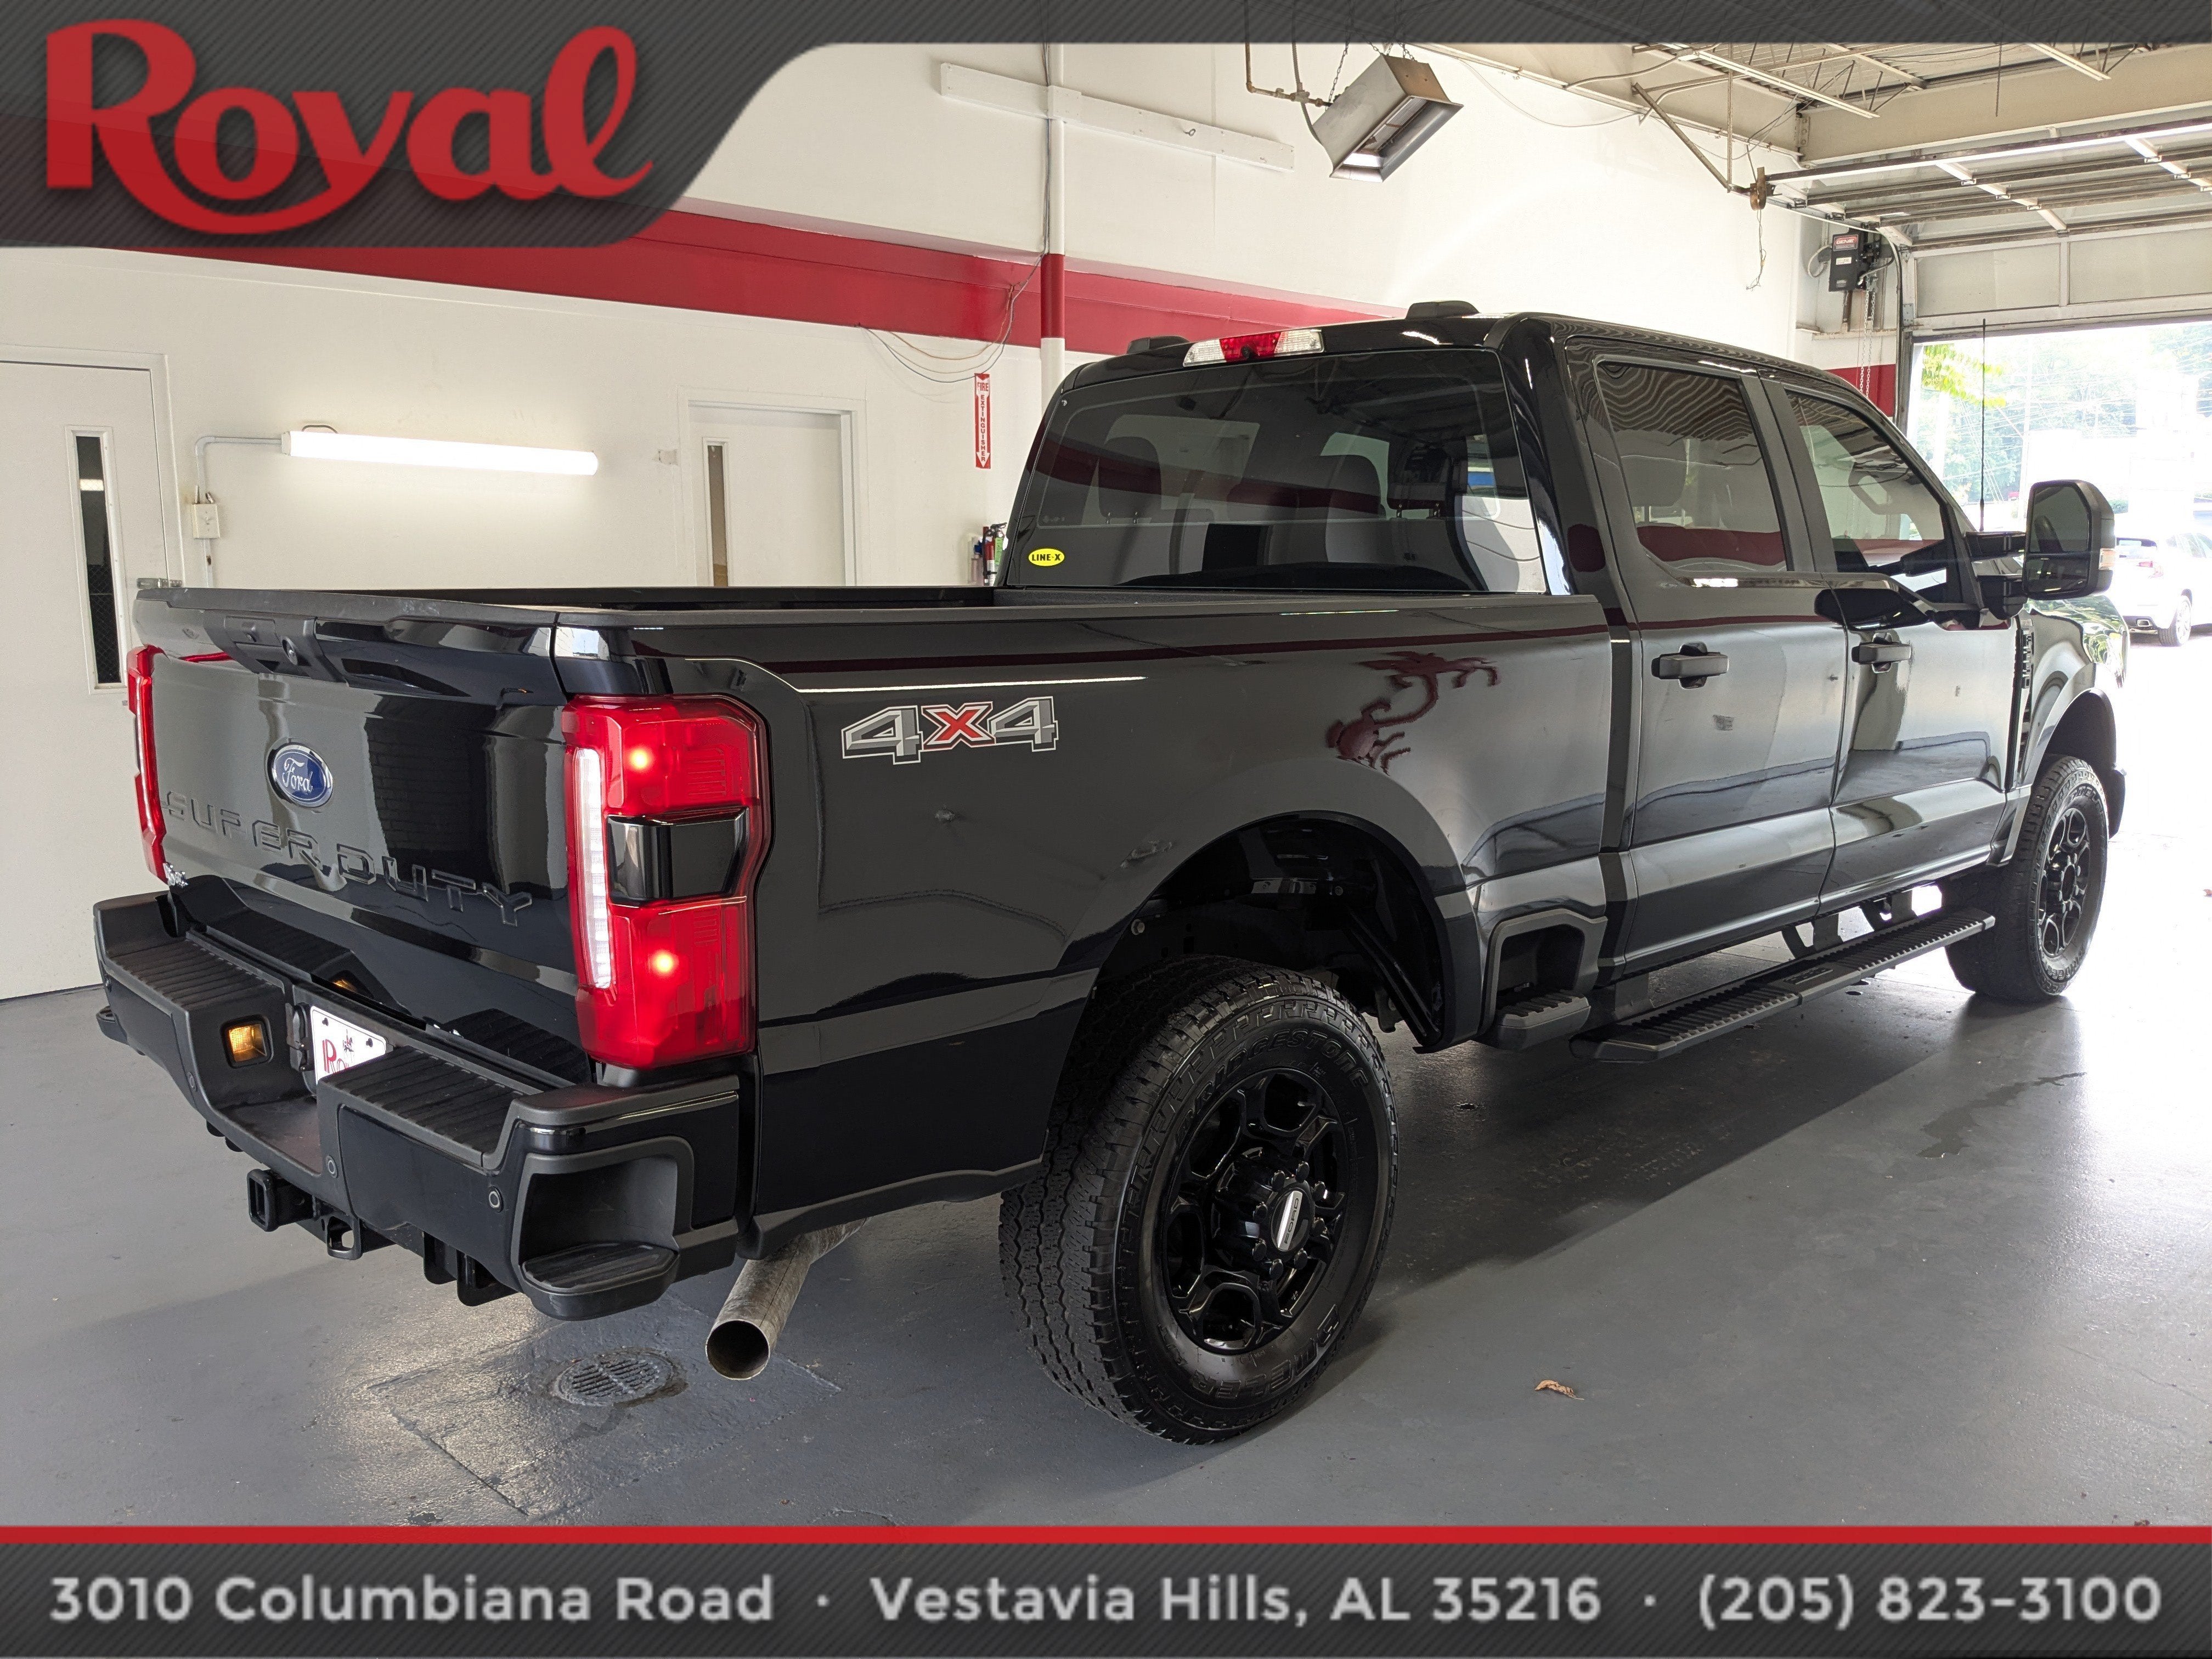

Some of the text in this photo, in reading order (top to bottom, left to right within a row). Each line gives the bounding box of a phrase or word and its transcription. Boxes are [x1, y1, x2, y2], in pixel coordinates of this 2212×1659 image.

[977, 381, 989, 392] FIRE
[1031, 553, 1062, 562] LINE-X
[281, 757, 313, 793] Ford
[166, 791, 533, 927] SUPER DUTY
